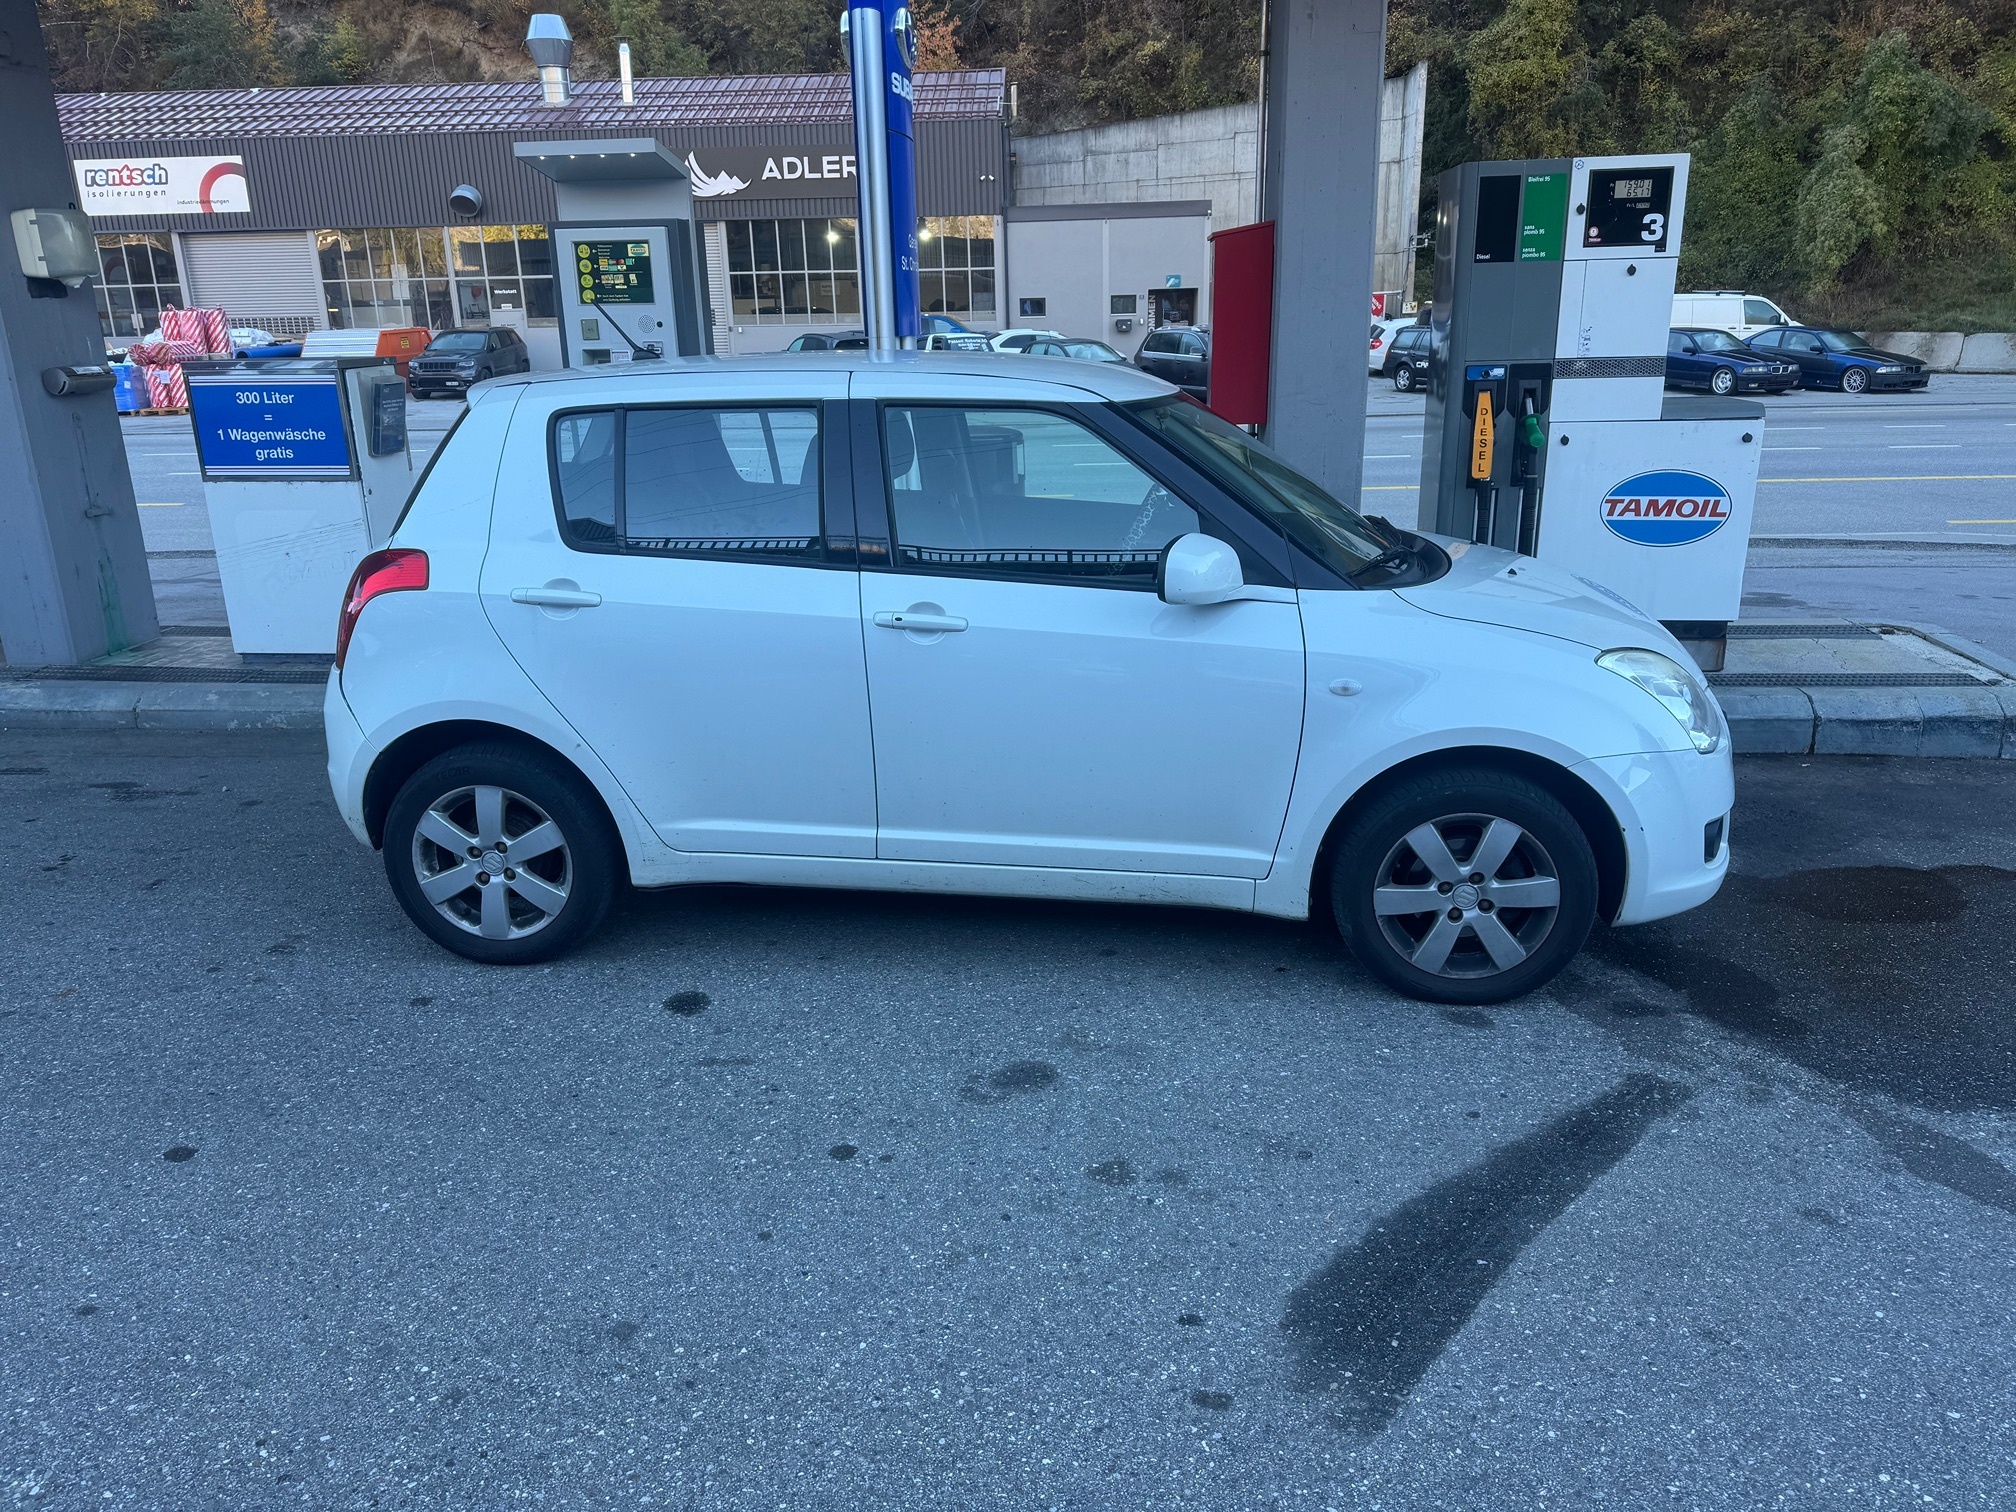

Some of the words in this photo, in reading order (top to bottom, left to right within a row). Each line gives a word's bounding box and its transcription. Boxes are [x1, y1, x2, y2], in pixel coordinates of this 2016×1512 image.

[84, 163, 168, 187] rentsch
[761, 155, 856, 180] ADLER
[1624, 180, 1651, 188] 159.01
[1626, 188, 1650, 196] 65.17
[87, 189, 166, 198] isolierungen
[1640, 213, 1664, 241] 3
[1148, 294, 1156, 333] OMMEN
[235, 391, 260, 404] 300
[263, 391, 294, 404] Liter
[217, 429, 224, 440] 1
[228, 428, 326, 443] Wagenwäsche
[1478, 407, 1489, 473] DIESEL
[255, 446, 294, 461] gratis
[1604, 498, 1728, 518] TAMOIL
